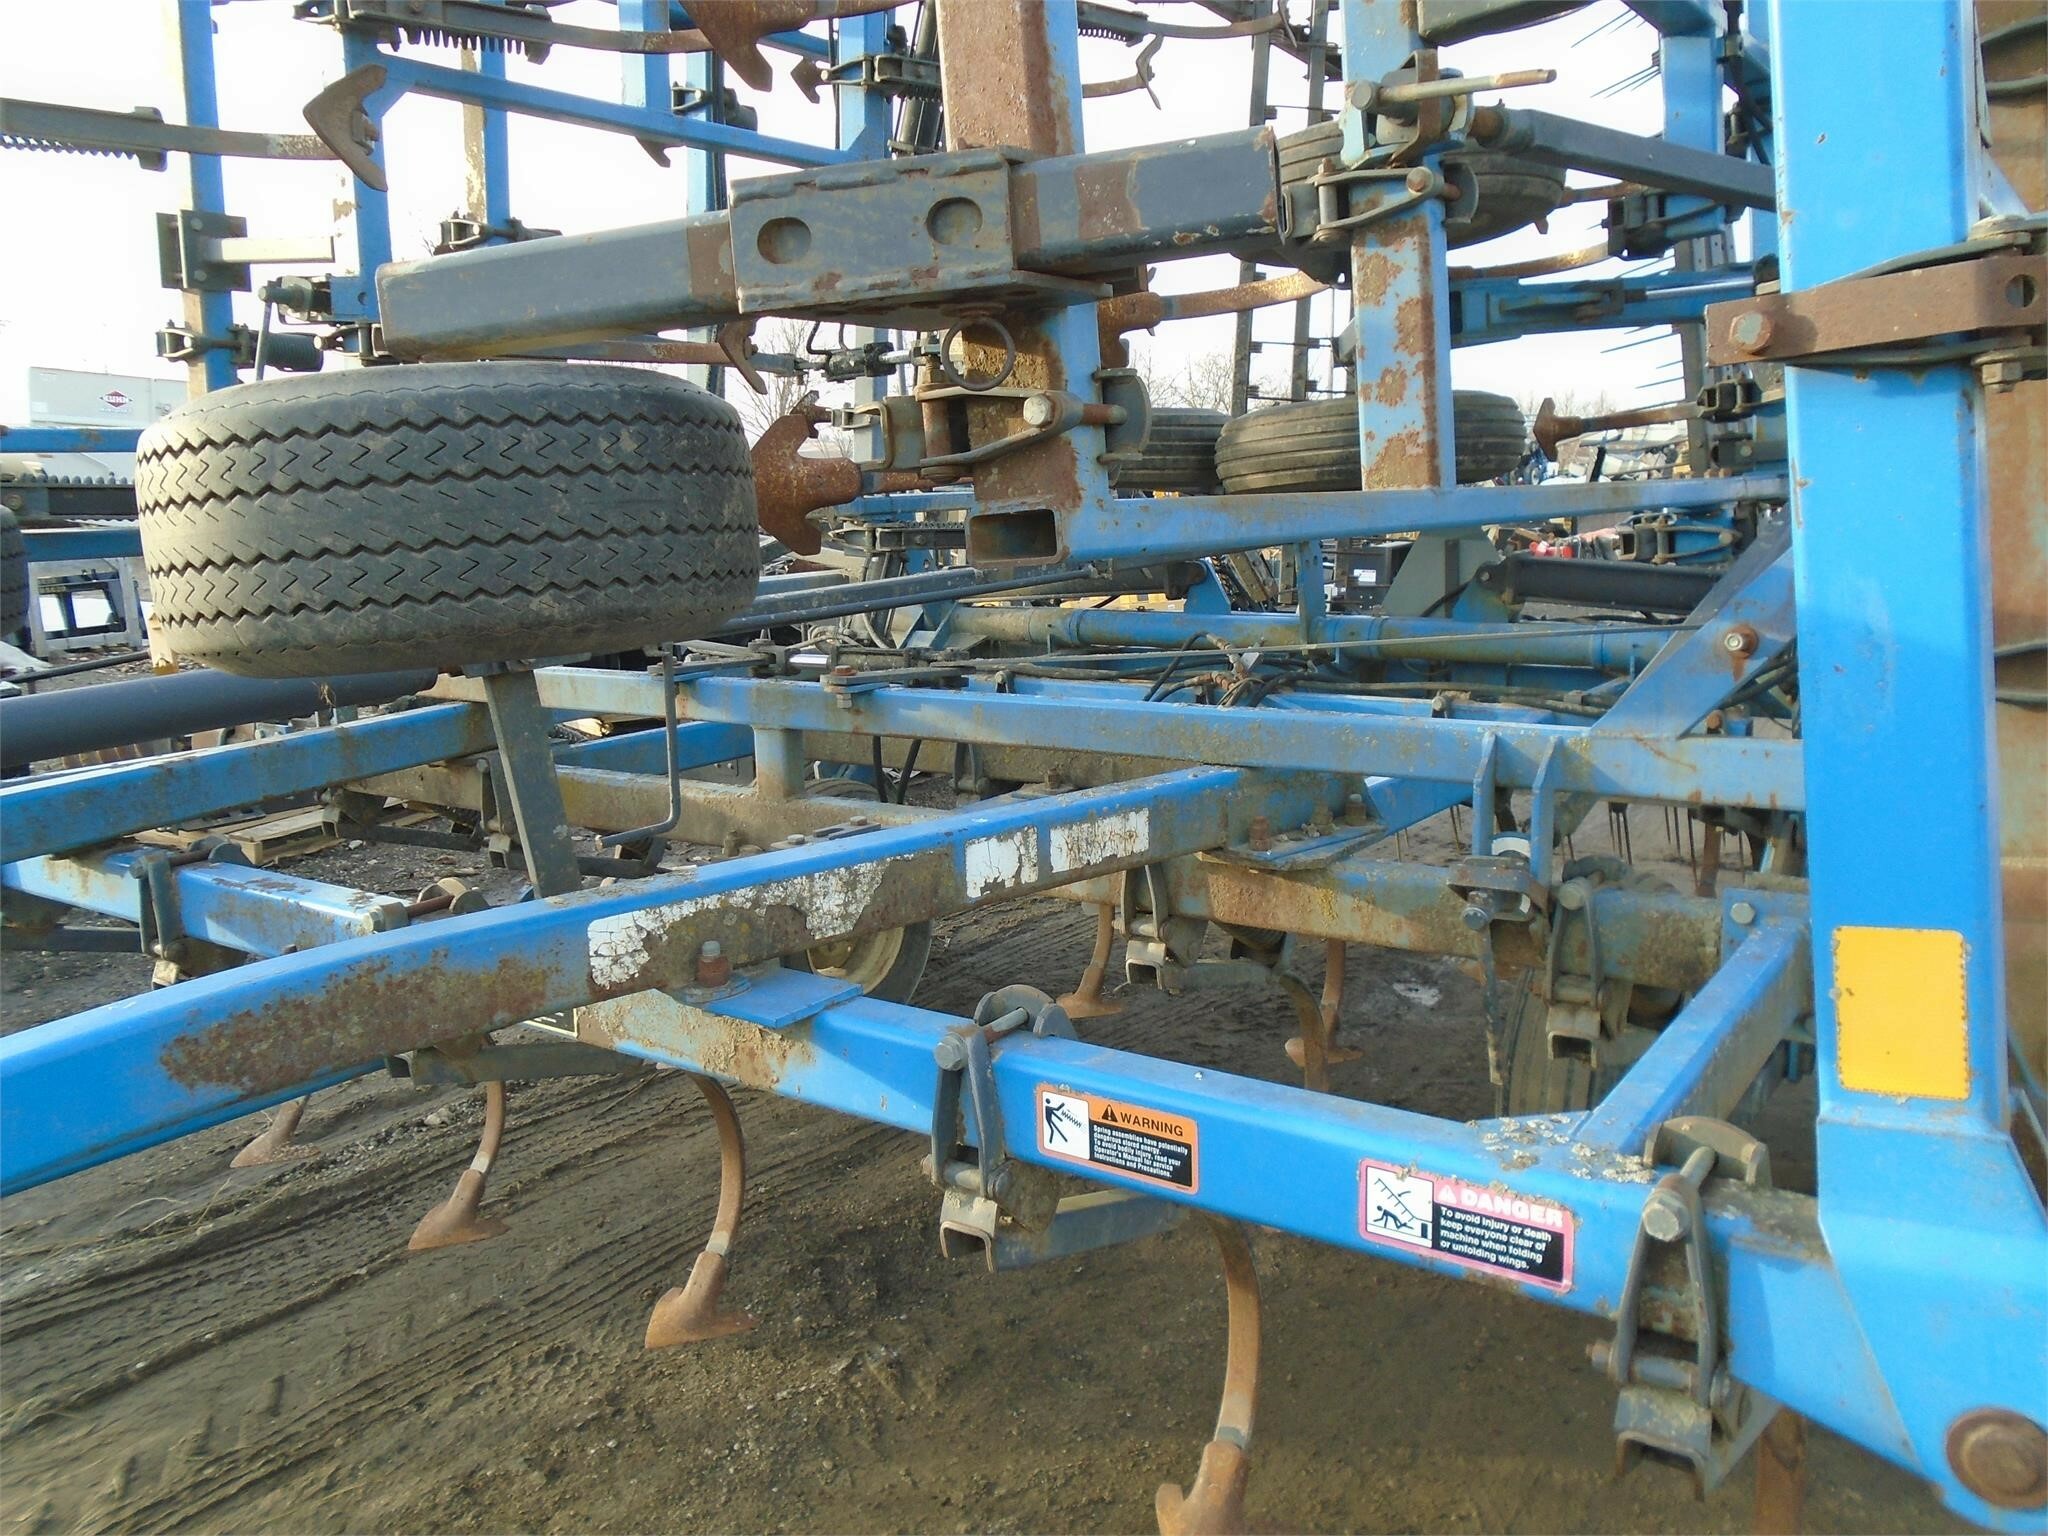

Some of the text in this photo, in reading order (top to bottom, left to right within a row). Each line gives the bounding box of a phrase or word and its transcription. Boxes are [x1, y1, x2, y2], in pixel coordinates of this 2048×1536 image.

[1121, 1112, 1183, 1136] WARNING
[1094, 1125, 1188, 1155] Spring assemblies have potentially
[1094, 1133, 1161, 1154] dangerous stored energy.
[1102, 1141, 1116, 1149] avoid
[1118, 1145, 1134, 1155] bodily
[1155, 1155, 1167, 1163] read
[1169, 1158, 1180, 1166] your
[1094, 1146, 1121, 1157] Operator's
[1123, 1153, 1143, 1163] Manual
[1153, 1162, 1173, 1171] service
[1094, 1152, 1125, 1165] Instructions
[1138, 1163, 1172, 1177] Precautions.
[1461, 1188, 1562, 1227] DANGER
[1441, 1207, 1551, 1242] To avoid injury or death
[1441, 1218, 1546, 1251] keep everyone clear of
[1440, 1229, 1542, 1263] machine when folding
[1440, 1240, 1529, 1269] or unfolding wings.
